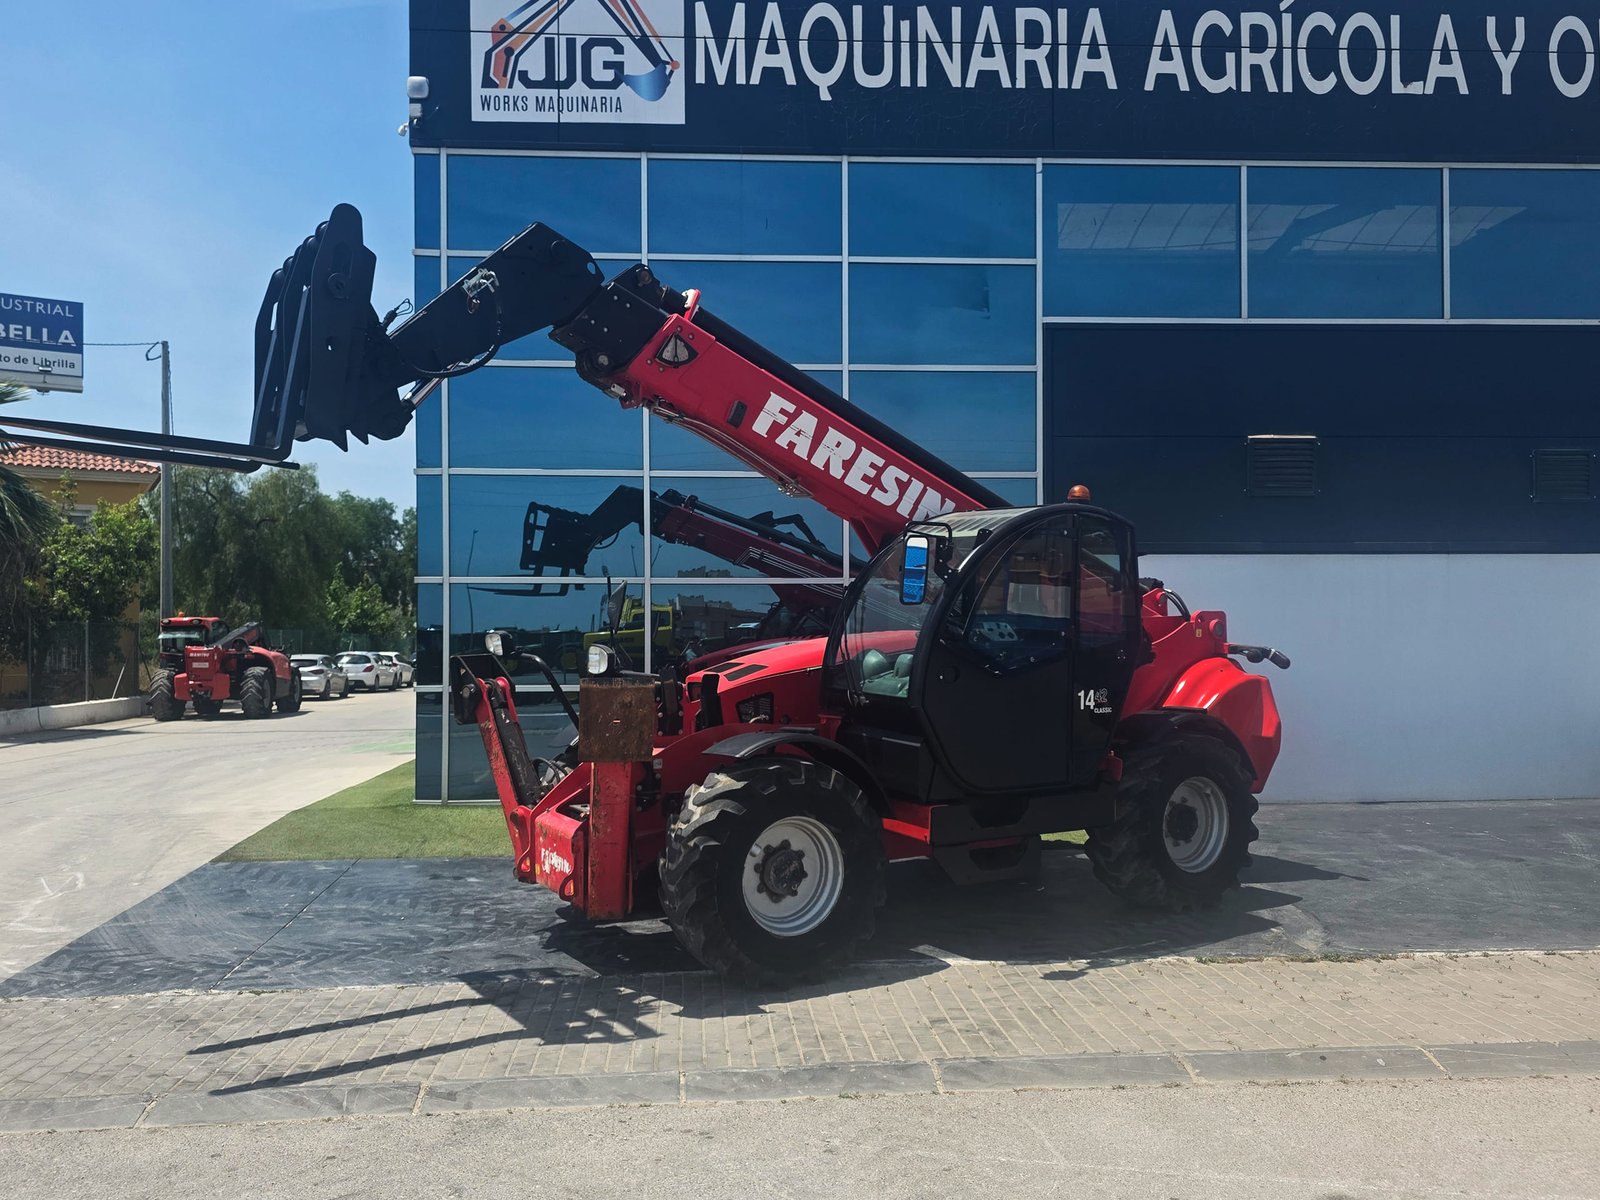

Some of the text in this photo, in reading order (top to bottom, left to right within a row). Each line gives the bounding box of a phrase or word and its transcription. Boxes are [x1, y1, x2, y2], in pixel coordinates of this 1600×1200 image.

[694, 0, 1600, 101] MAQUINARIA AGRÍCOLA Y O
[480, 94, 623, 114] WORKS MAQUINARIA
[1, 297, 74, 317] USTRIAL
[14, 355, 28, 364] de
[33, 356, 75, 368] Librilla
[751, 391, 956, 522] FARESIN
